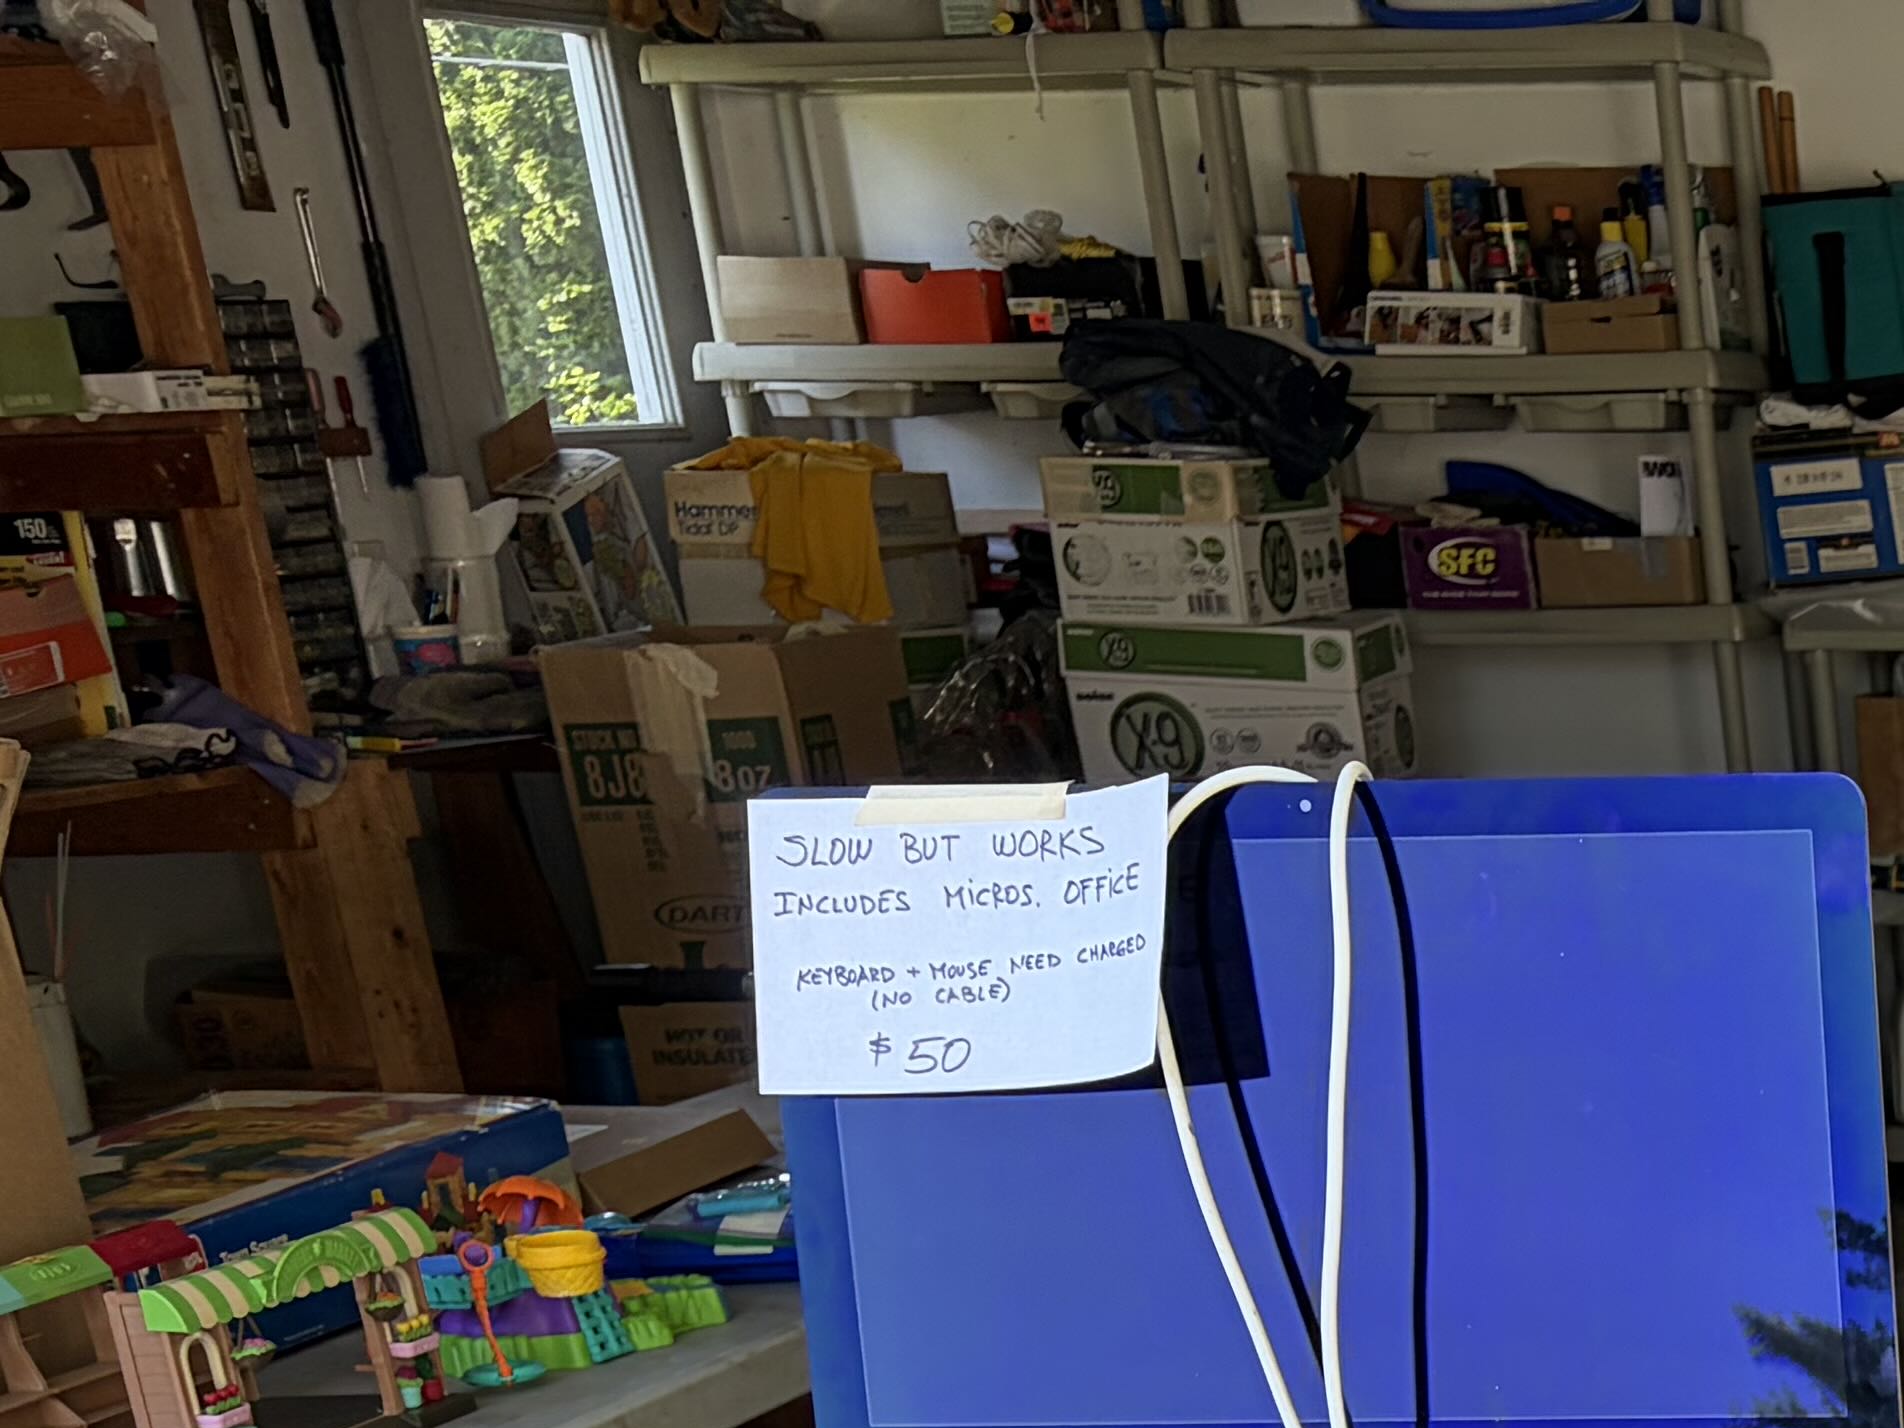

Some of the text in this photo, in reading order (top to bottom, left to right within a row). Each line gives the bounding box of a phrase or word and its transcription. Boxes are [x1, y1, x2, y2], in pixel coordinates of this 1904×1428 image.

[775, 826, 1106, 867] SLOW BUT WORKS
[773, 890, 912, 917] INCLUDES
[795, 964, 896, 993] KEYBOARD
[1010, 951, 1062, 974] NEED
[1077, 933, 1147, 966] CHARGED
[872, 981, 1011, 1012] (NO CABLE)
